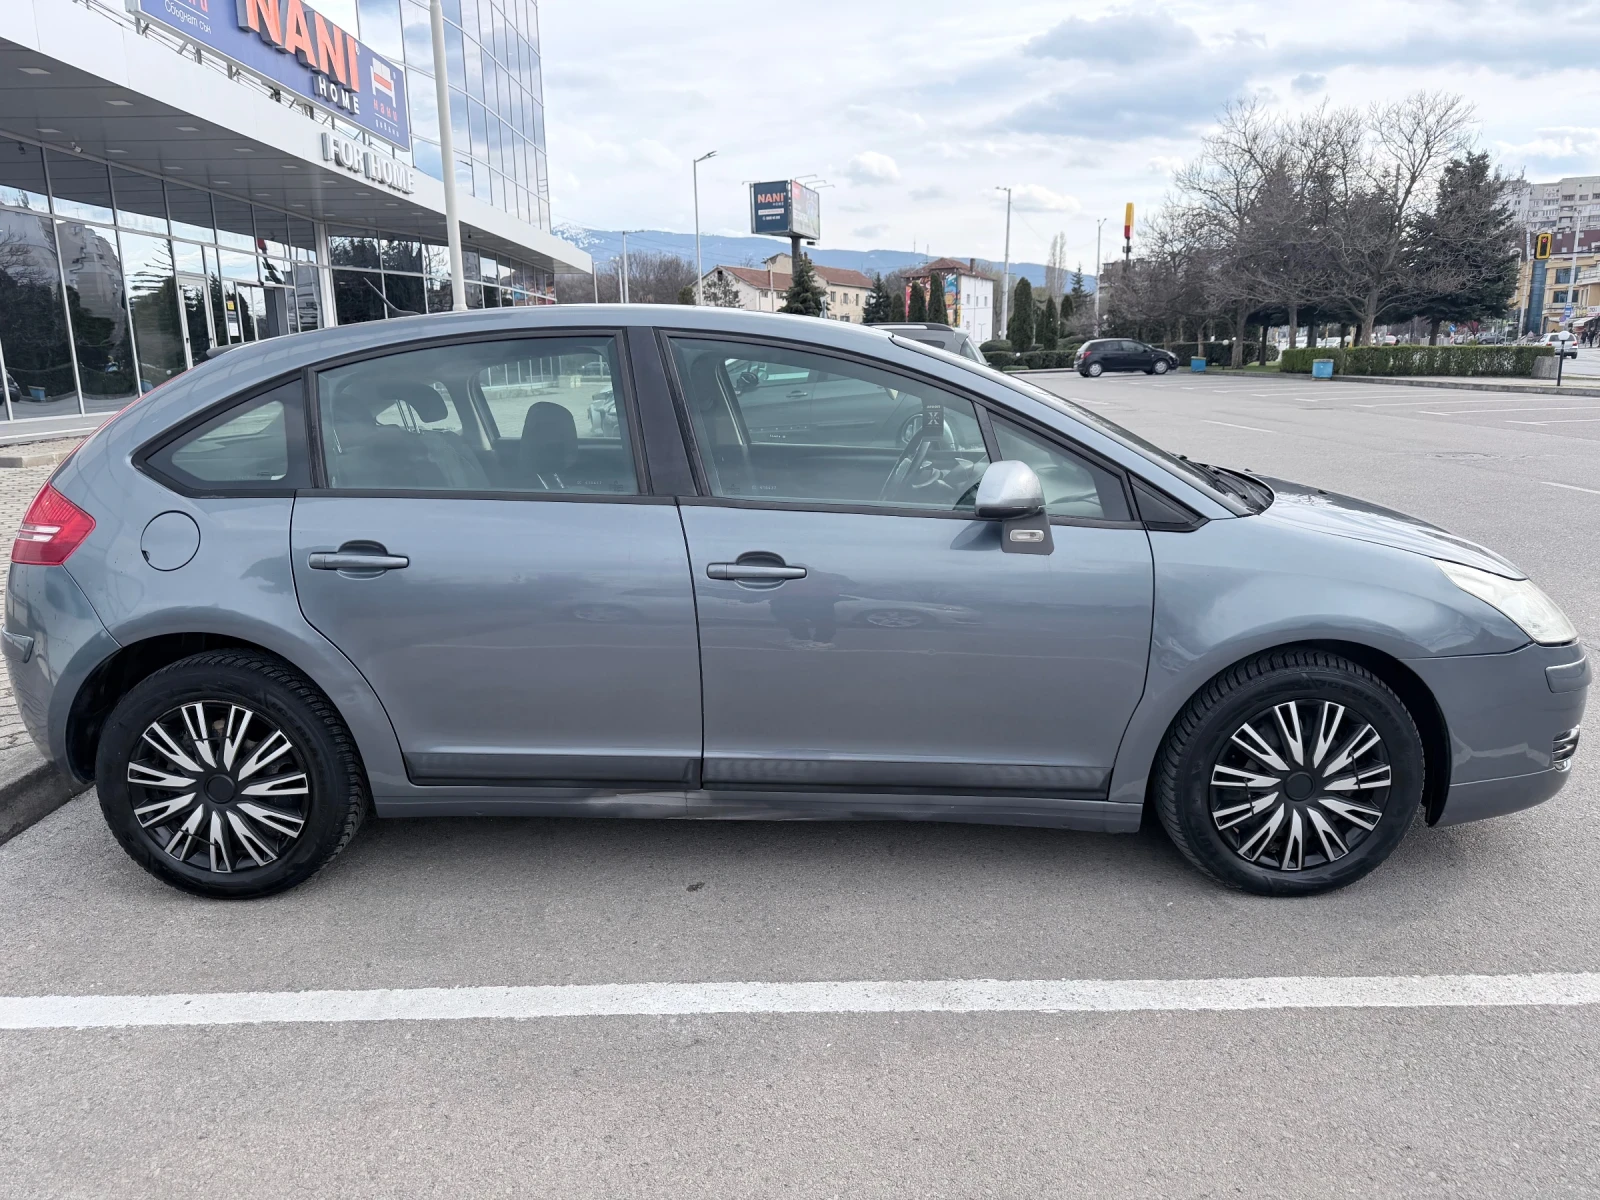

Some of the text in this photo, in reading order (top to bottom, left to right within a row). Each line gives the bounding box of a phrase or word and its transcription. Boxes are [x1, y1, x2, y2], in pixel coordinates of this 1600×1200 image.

[239, 0, 359, 93] NANI
[317, 75, 360, 115] HOME
[322, 133, 414, 194] FOR HOME
[758, 193, 784, 203] NANI
